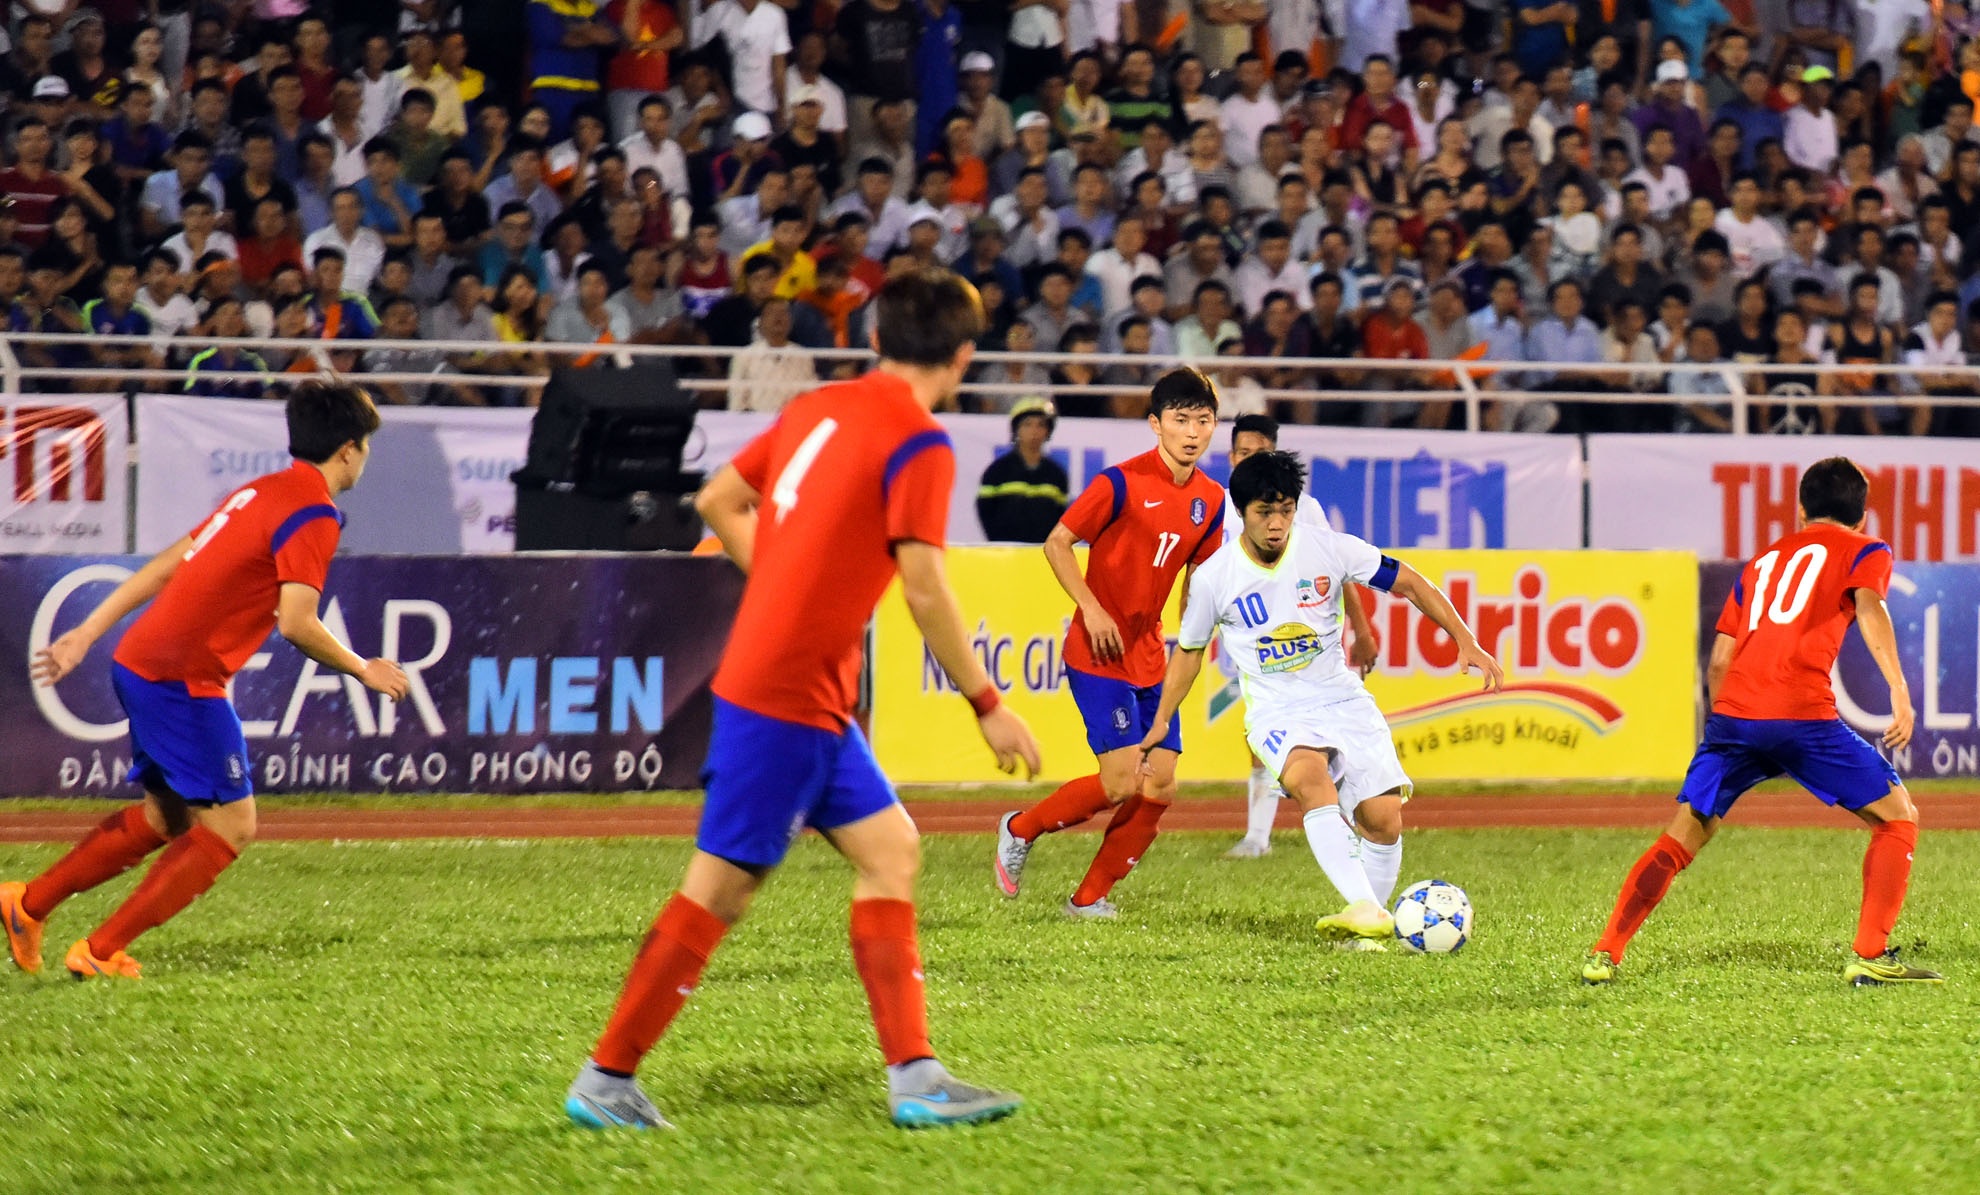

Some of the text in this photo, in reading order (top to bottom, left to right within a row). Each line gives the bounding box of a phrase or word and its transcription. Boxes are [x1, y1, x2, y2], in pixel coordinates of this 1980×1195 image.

[771, 417, 839, 524] 4
[1311, 447, 1505, 549] NIÊN
[1712, 463, 1945, 562] THNH
[1152, 531, 1180, 568] 17
[1749, 543, 1828, 632] 10
[1232, 592, 1269, 628] 10
[1343, 570, 1639, 669] Bidrico
[467, 656, 663, 736] MEN
[371, 752, 448, 786] CAO
[468, 750, 593, 784] PHONG
[613, 743, 664, 791] ĐỘ
